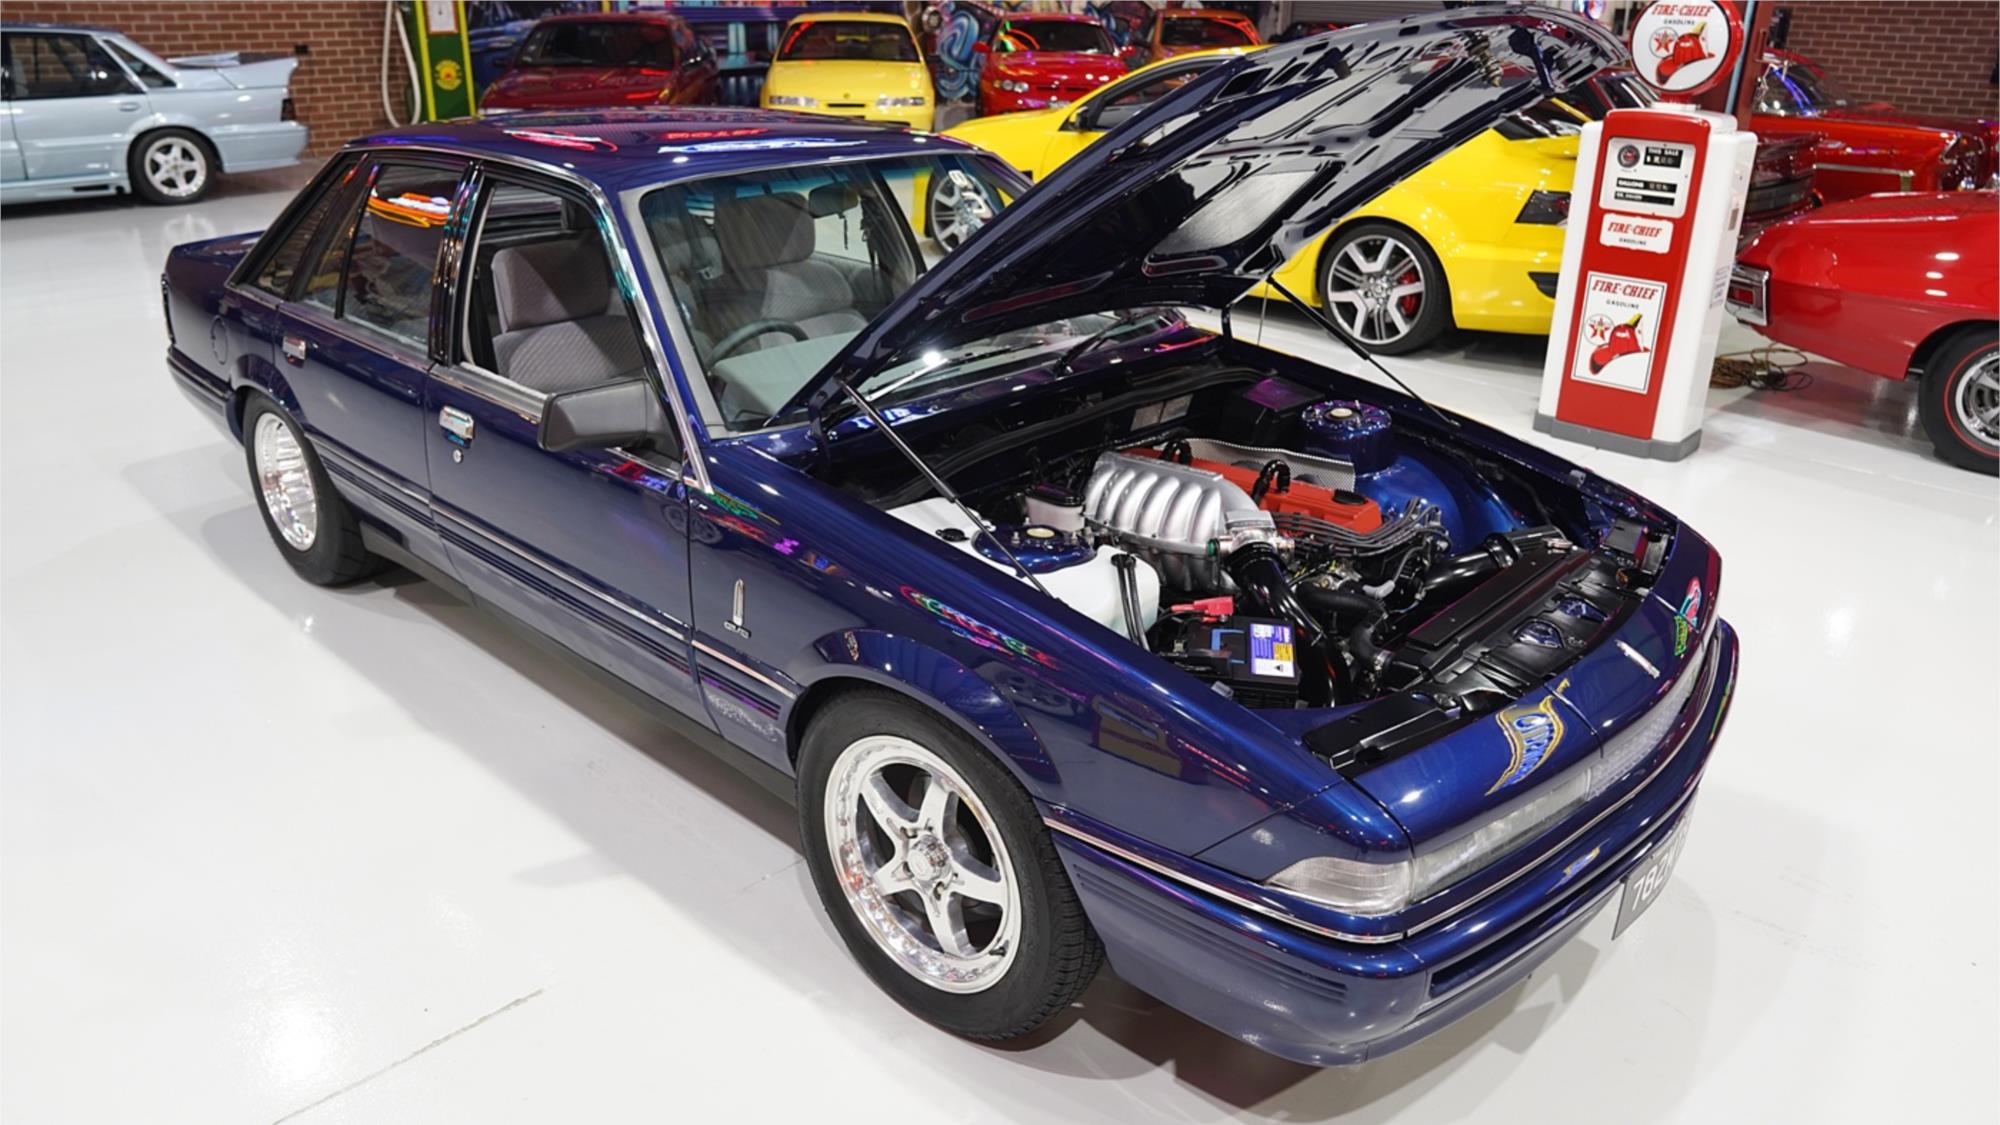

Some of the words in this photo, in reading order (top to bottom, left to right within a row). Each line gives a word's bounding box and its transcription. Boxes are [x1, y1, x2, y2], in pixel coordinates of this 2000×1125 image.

[1618, 237, 1646, 245] GASOLINE
[1592, 280, 1659, 300] FIRE-CHIEF
[1606, 299, 1639, 309] GASOLINE
